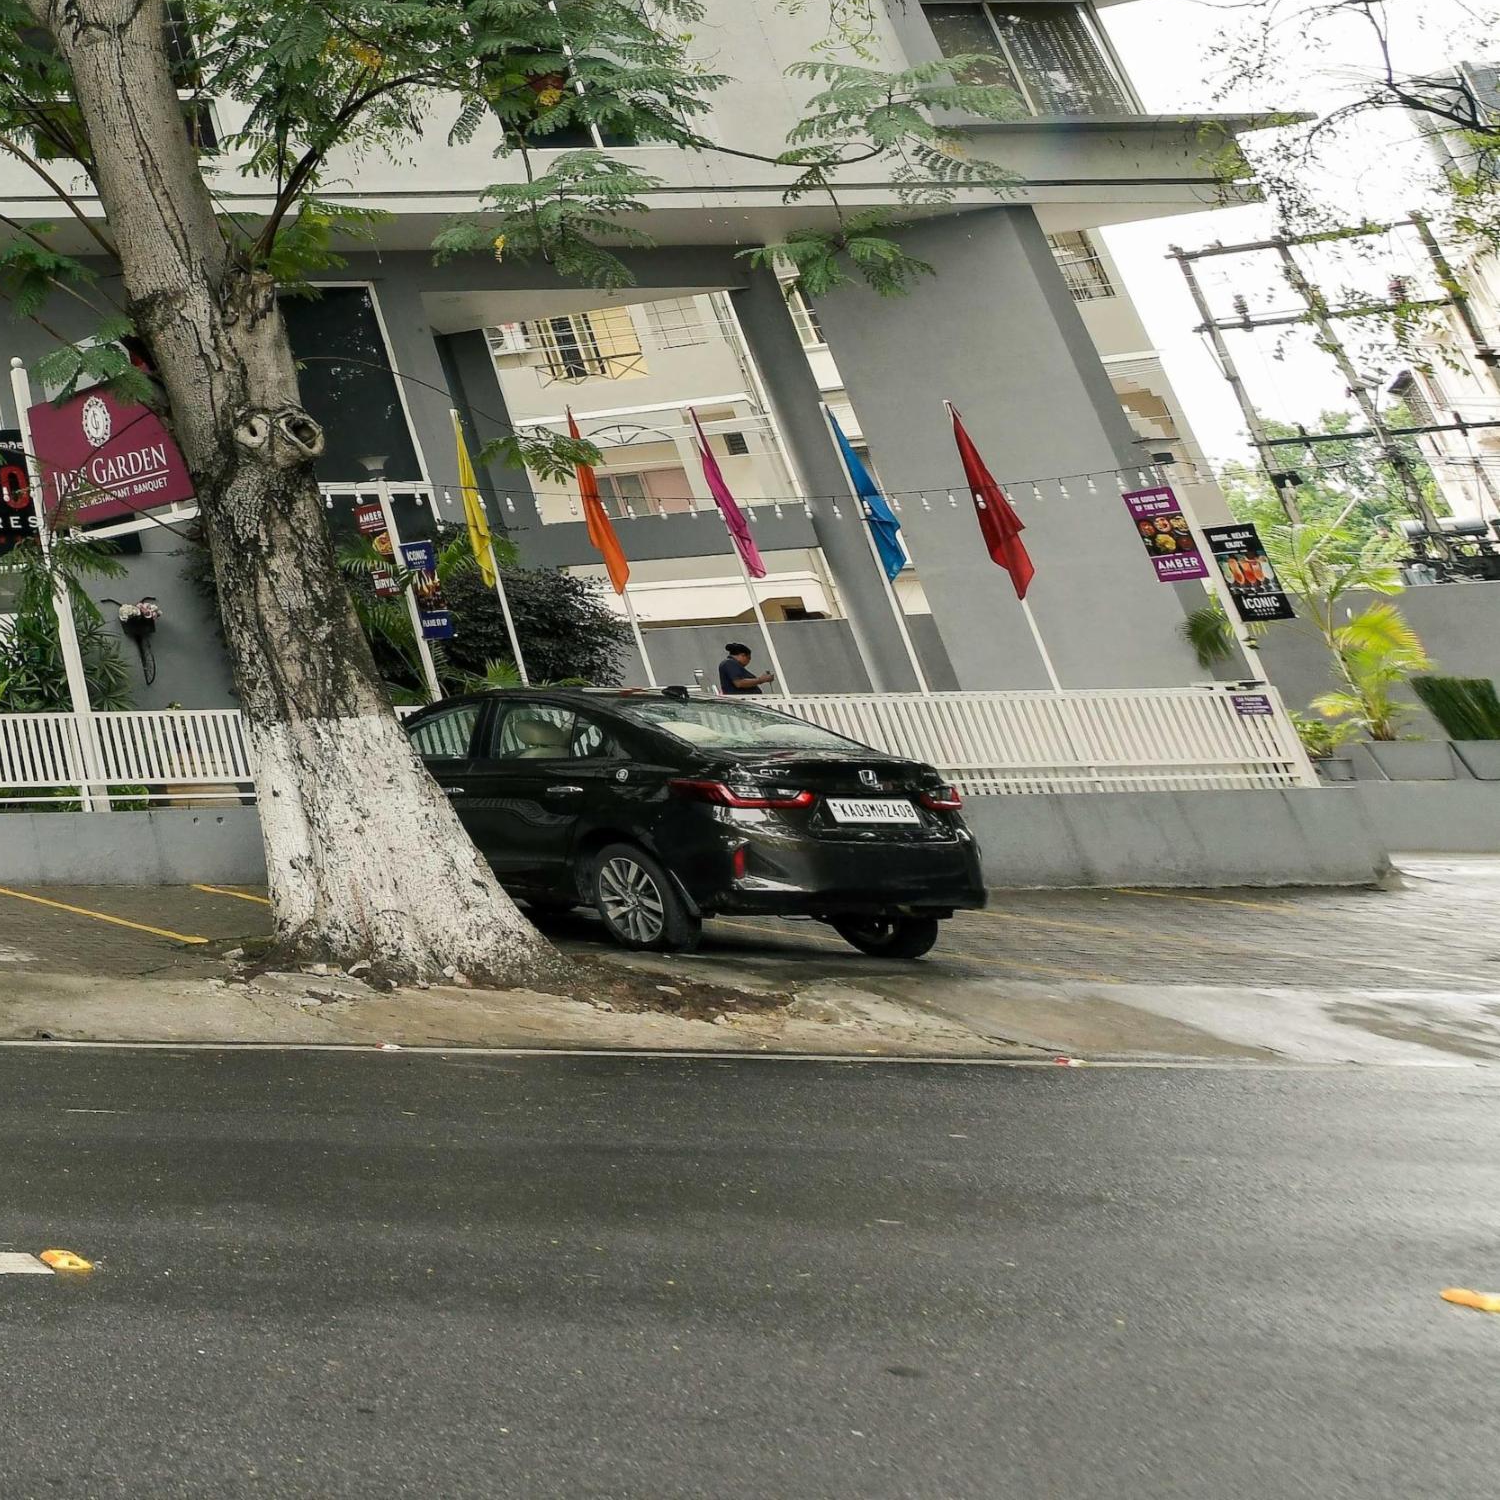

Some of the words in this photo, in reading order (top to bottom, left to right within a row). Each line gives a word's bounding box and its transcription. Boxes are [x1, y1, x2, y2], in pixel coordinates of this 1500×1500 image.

[92, 444, 168, 486] GARDEN
[134, 477, 168, 494] BANQUET
[360, 510, 383, 522] AMBER
[406, 549, 428, 562] ICONIC
[1158, 557, 1199, 570] AMBER
[1242, 595, 1280, 609] ICONIC
[759, 768, 791, 777] CITY
[840, 801, 916, 819] KA09MH2408
